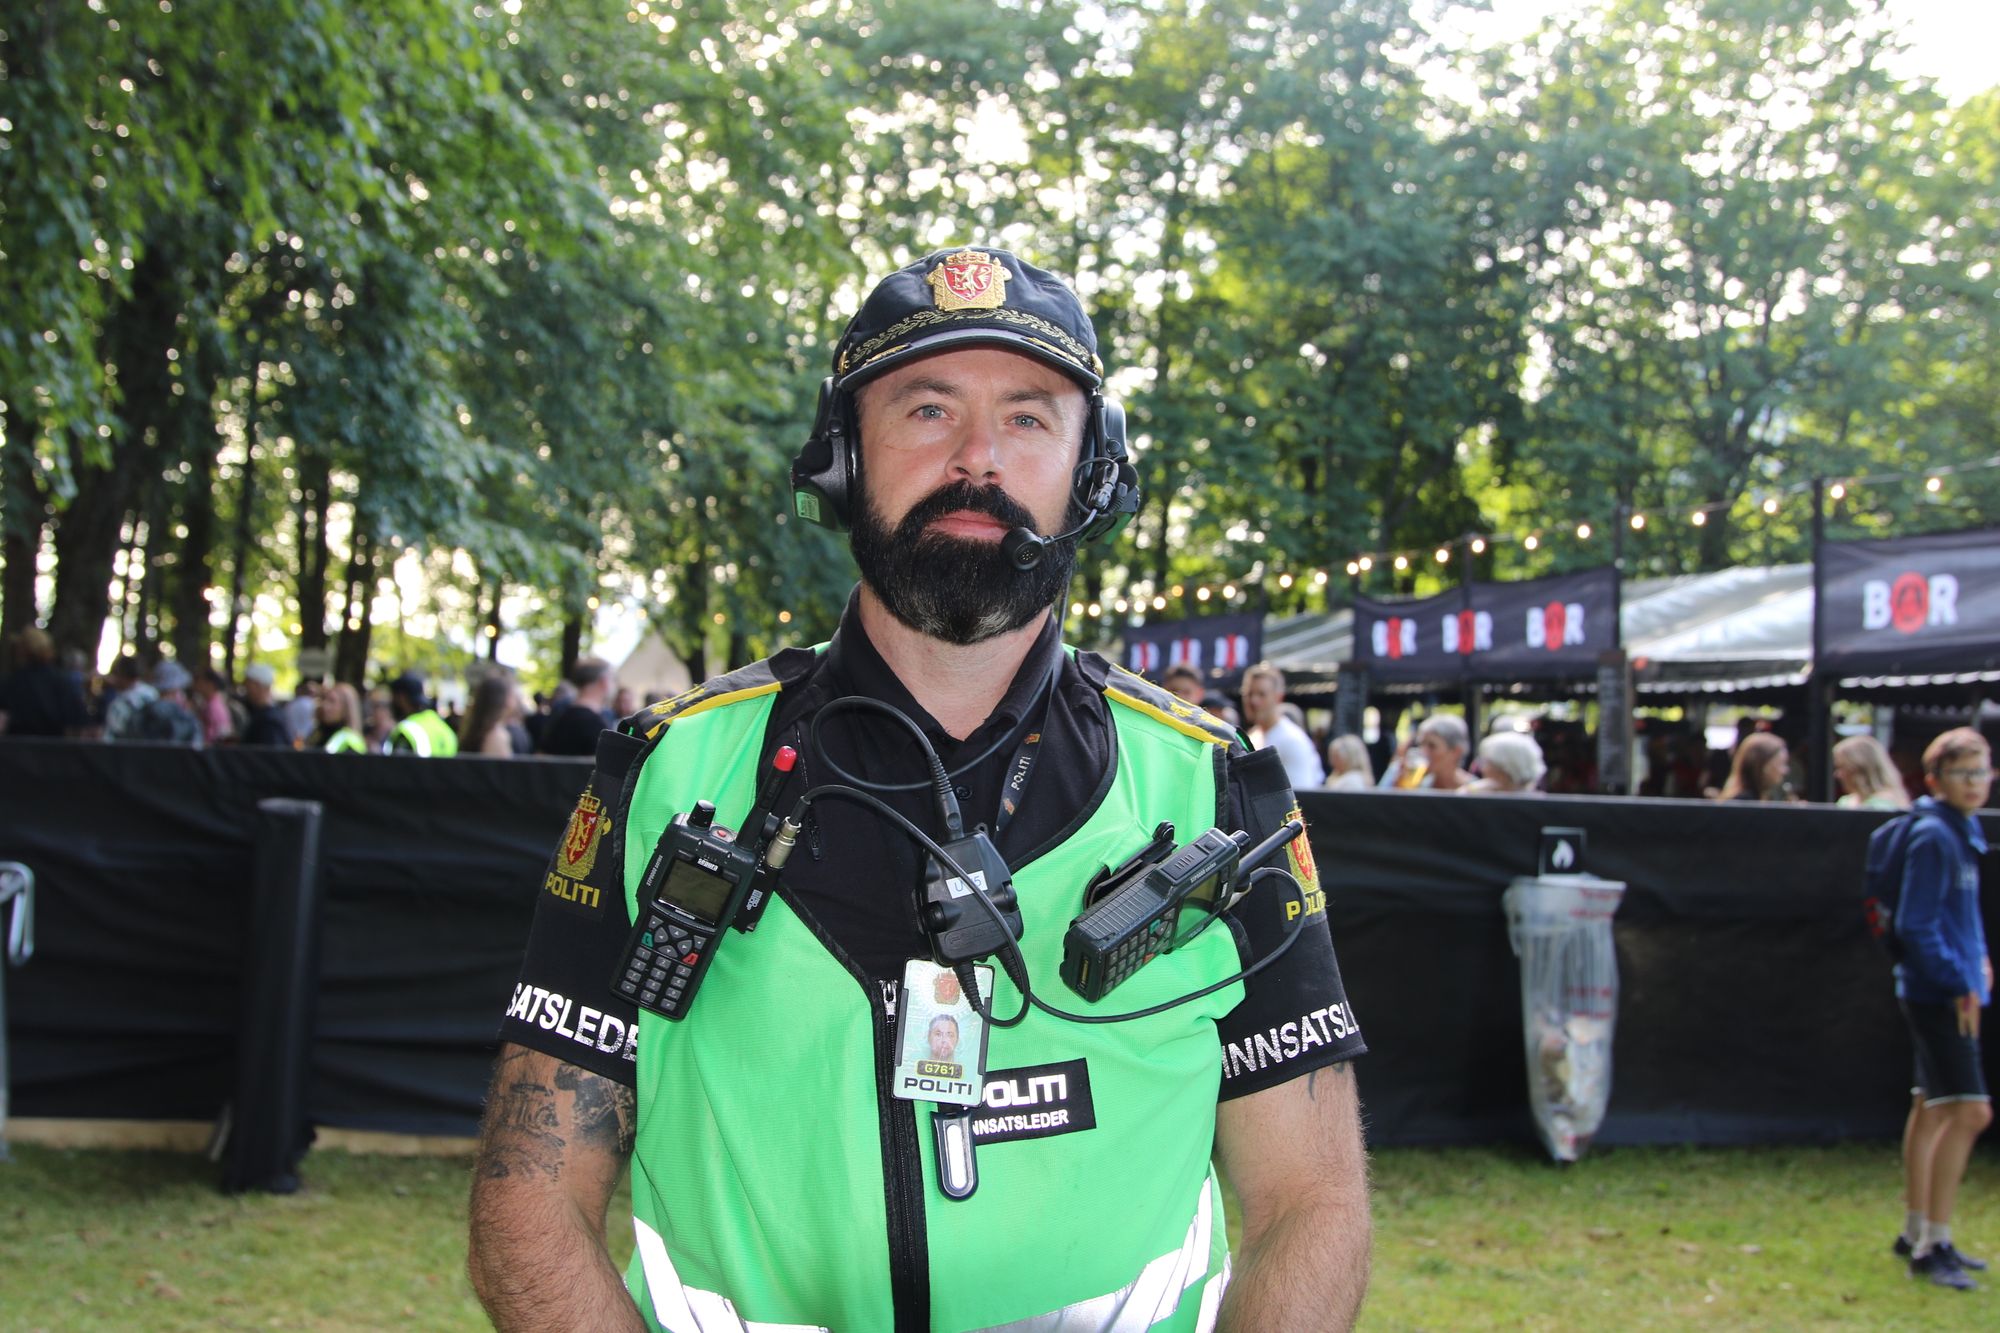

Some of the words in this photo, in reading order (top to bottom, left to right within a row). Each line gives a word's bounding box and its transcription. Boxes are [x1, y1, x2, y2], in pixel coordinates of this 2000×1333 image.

[1010, 756, 1032, 791] POLITI
[544, 871, 600, 909] POLITI
[1221, 1000, 1360, 1079] INNSATSL
[903, 1077, 973, 1096] POLITI
[924, 1063, 956, 1076] G761
[981, 1073, 1068, 1109] OLITI
